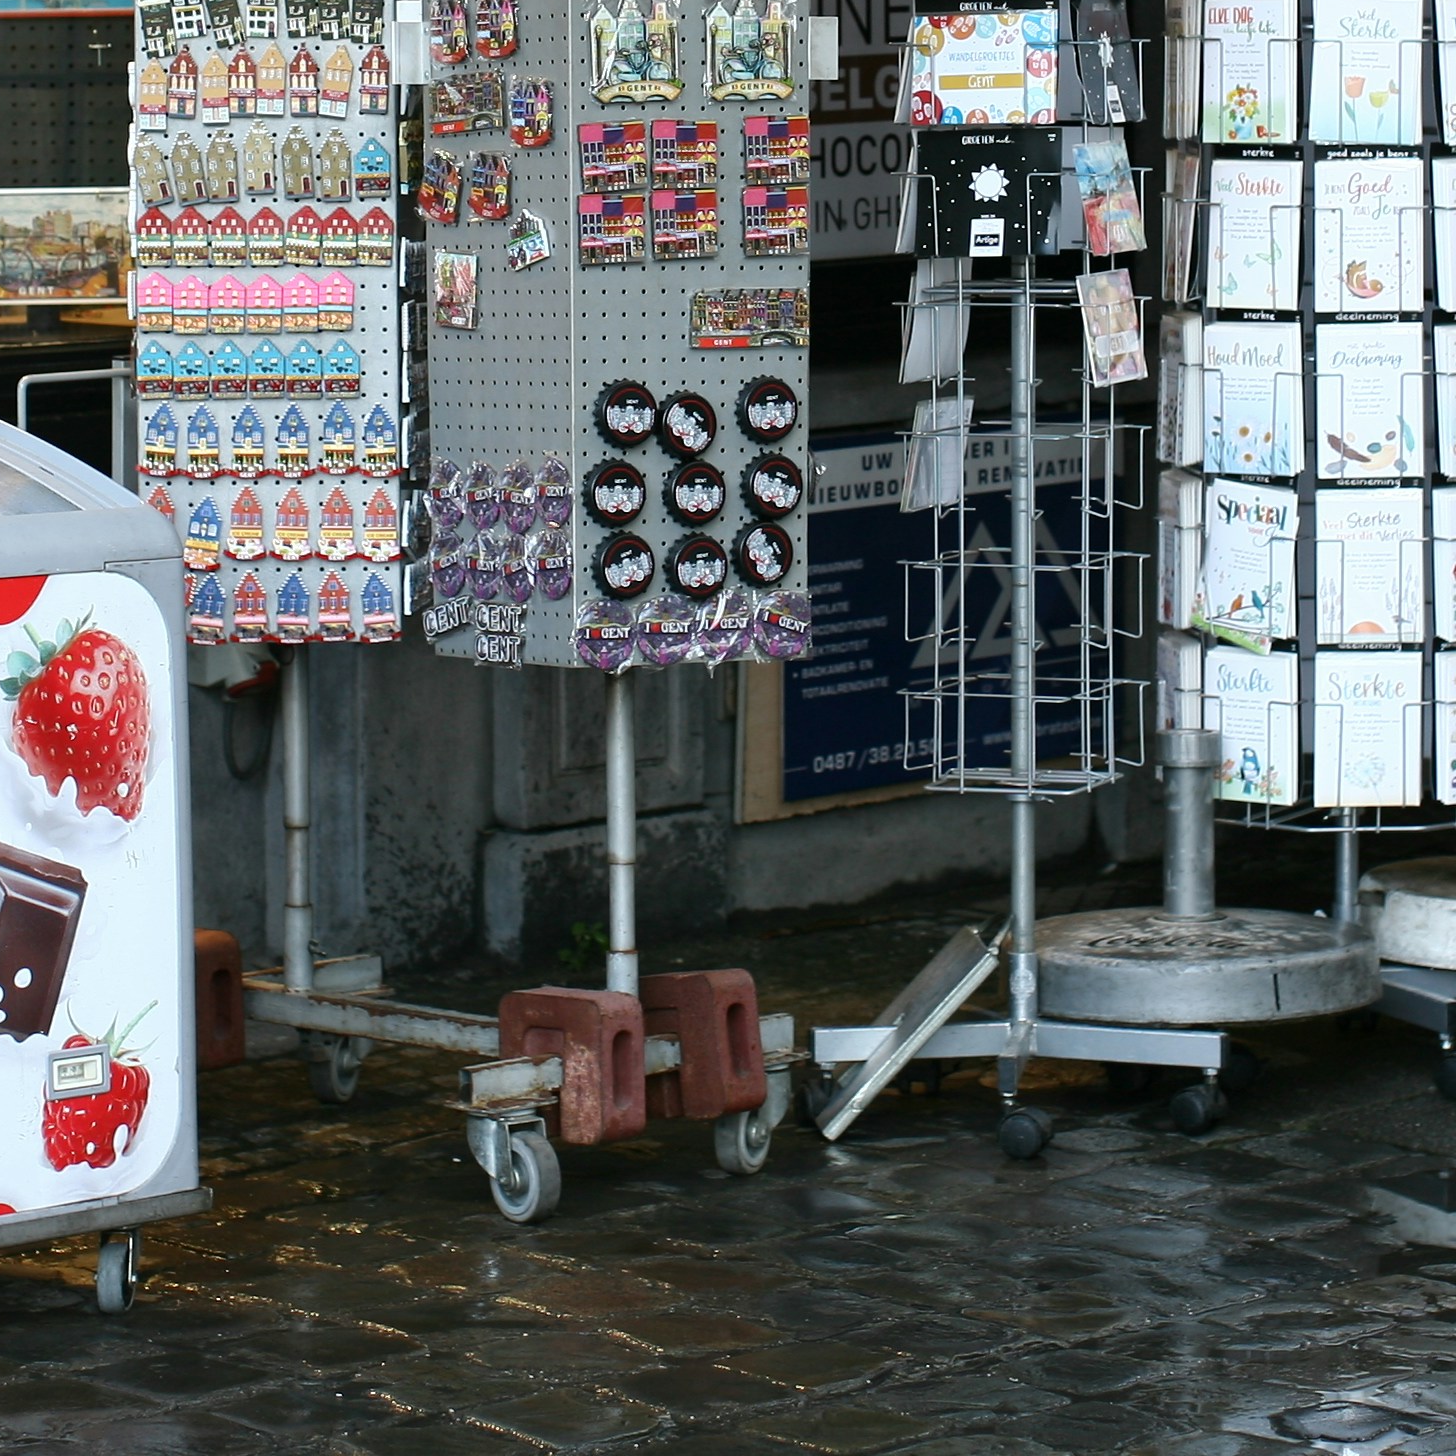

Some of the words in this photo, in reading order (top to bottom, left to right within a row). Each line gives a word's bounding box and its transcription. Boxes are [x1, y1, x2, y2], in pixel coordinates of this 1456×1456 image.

[1339, 16, 1399, 41] Sterkte
[626, 83, 653, 93] GENT
[967, 75, 995, 88] GENT
[1242, 148, 1275, 158] sterkte
[1234, 173, 1285, 197] Sterkte
[1347, 172, 1394, 204] Goed
[1243, 311, 1276, 321] sterkte
[861, 451, 893, 471] UW
[1217, 494, 1288, 532] Speciaal
[600, 626, 631, 640] GENT
[660, 620, 691, 634] GENT
[778, 613, 808, 634] GENT
[1327, 671, 1407, 701] Sterkte
